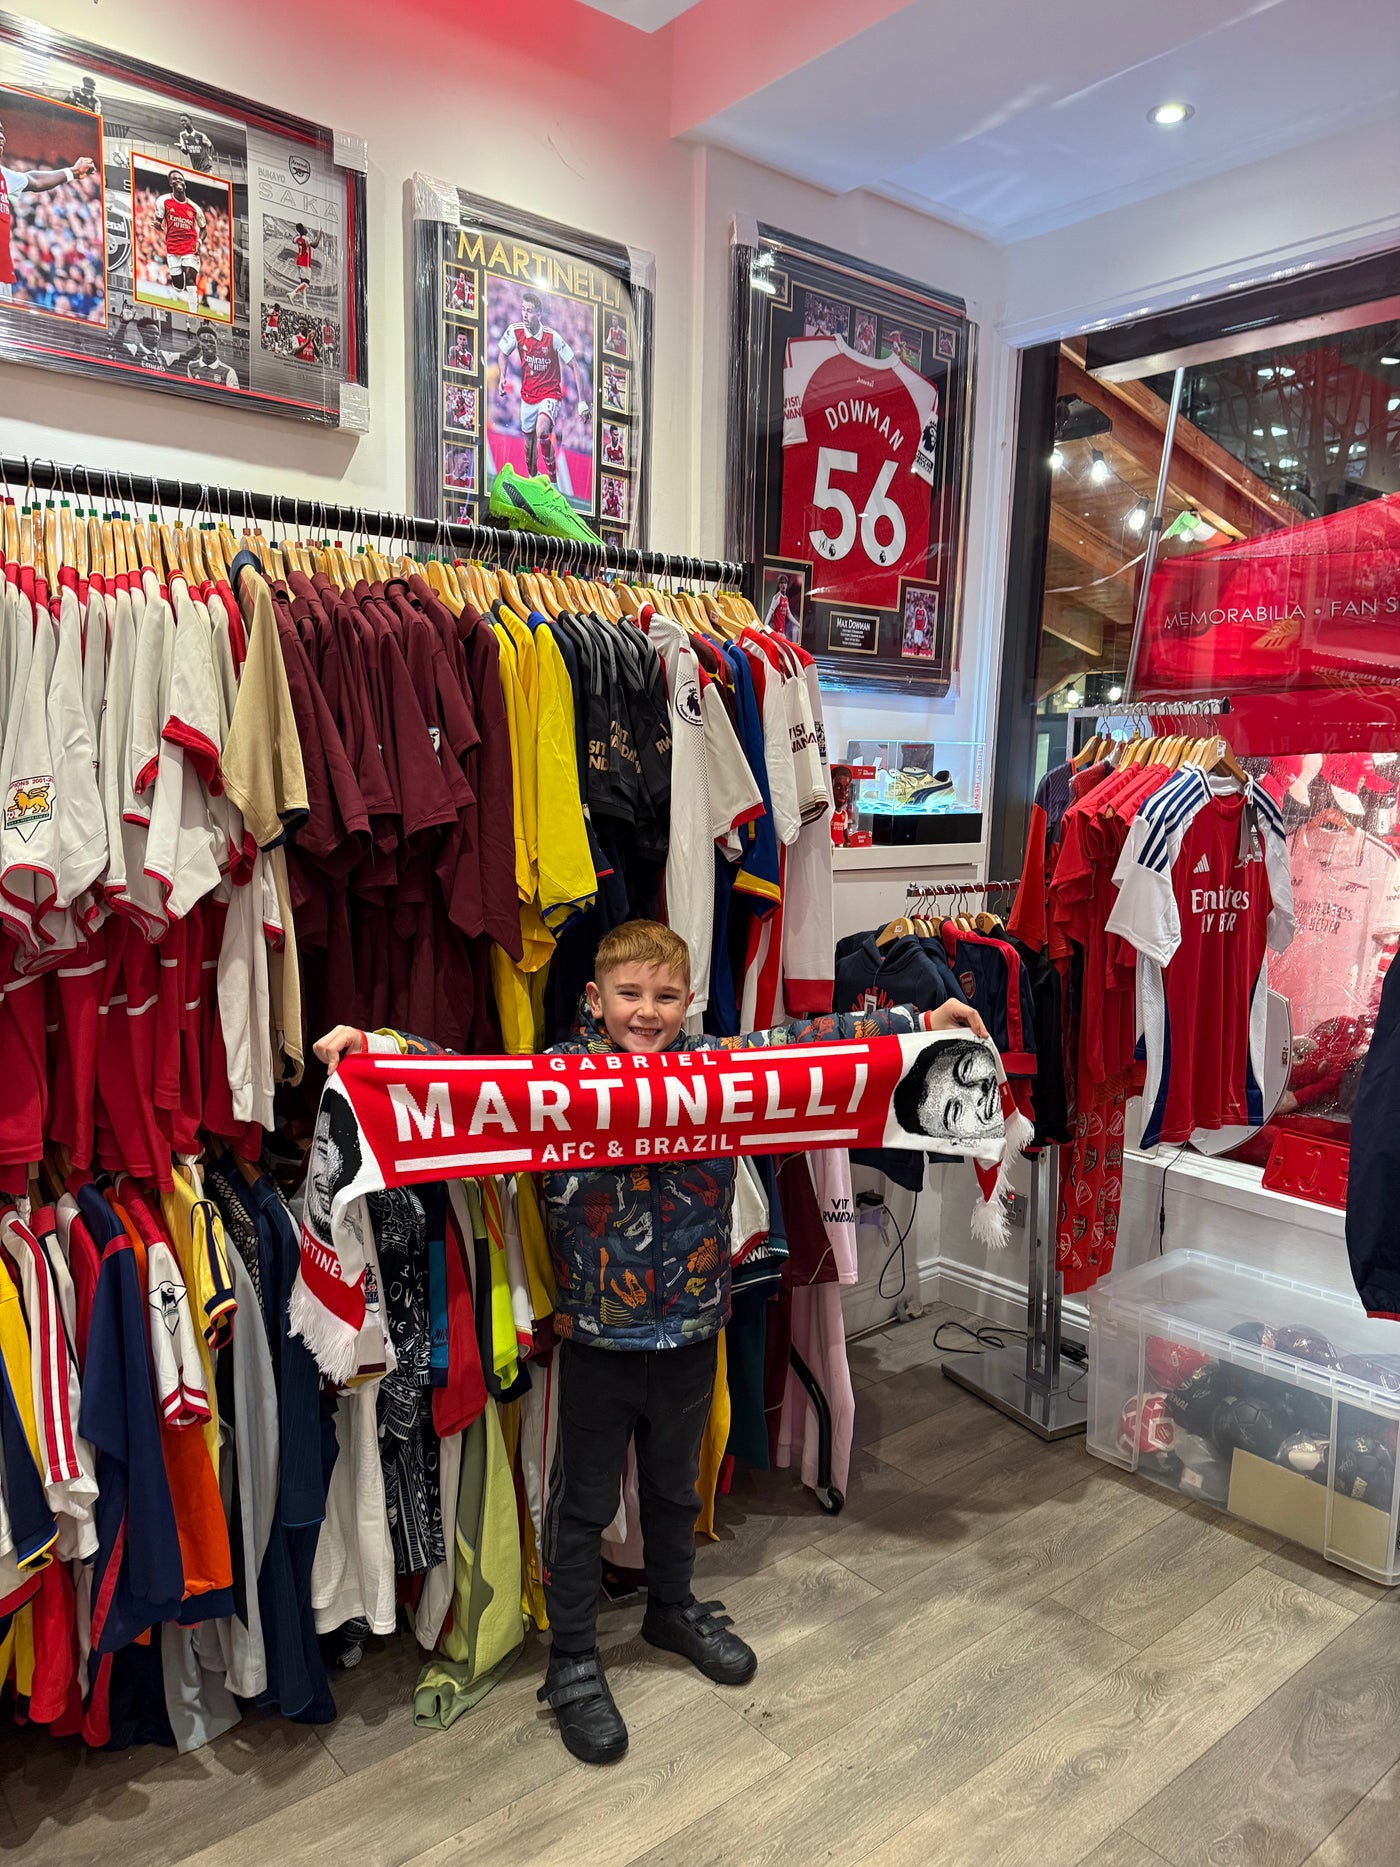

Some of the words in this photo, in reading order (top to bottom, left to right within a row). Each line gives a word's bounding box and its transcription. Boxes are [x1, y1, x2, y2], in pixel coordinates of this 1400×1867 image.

[258, 167, 286, 184] BUKAYO
[258, 182, 339, 221] SAKA
[457, 230, 623, 309] MARTINELLI
[824, 398, 905, 452] DOWMAN
[809, 446, 907, 567] 56
[1164, 604, 1306, 629] MEMORABILIA
[1330, 598, 1378, 617] FAN
[1385, 596, 1400, 613] S
[549, 1053, 717, 1072] GABRIEL
[386, 1063, 869, 1142] MARTINELLI
[541, 1141, 596, 1164] AFC
[606, 1139, 624, 1158] &
[634, 1133, 734, 1156] BRAZIL
